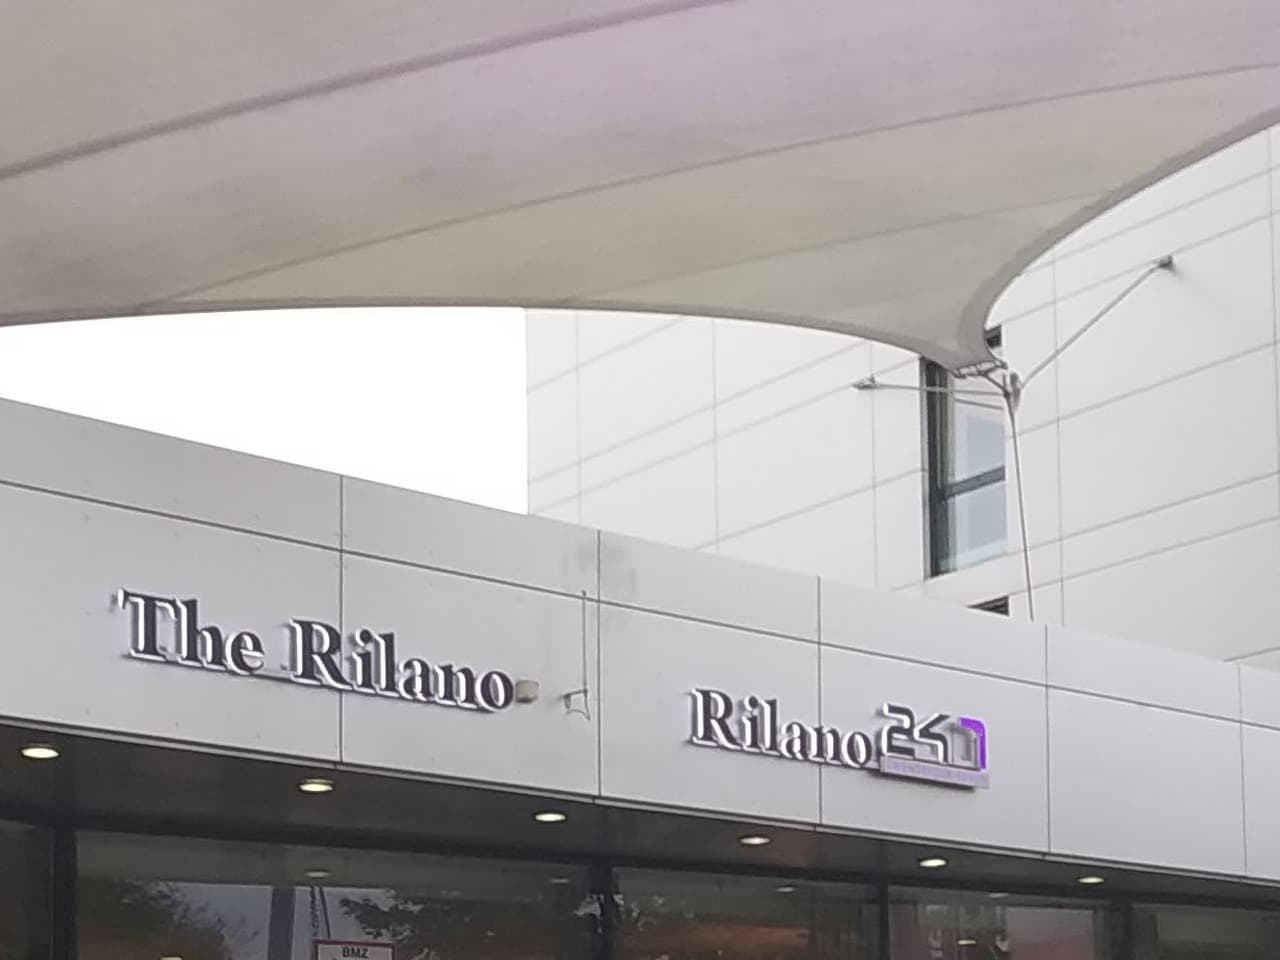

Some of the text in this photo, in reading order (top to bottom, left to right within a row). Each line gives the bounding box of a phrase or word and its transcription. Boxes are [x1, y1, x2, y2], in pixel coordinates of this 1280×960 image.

[114, 588, 516, 713] The Rilano
[689, 686, 873, 769] Rilano
